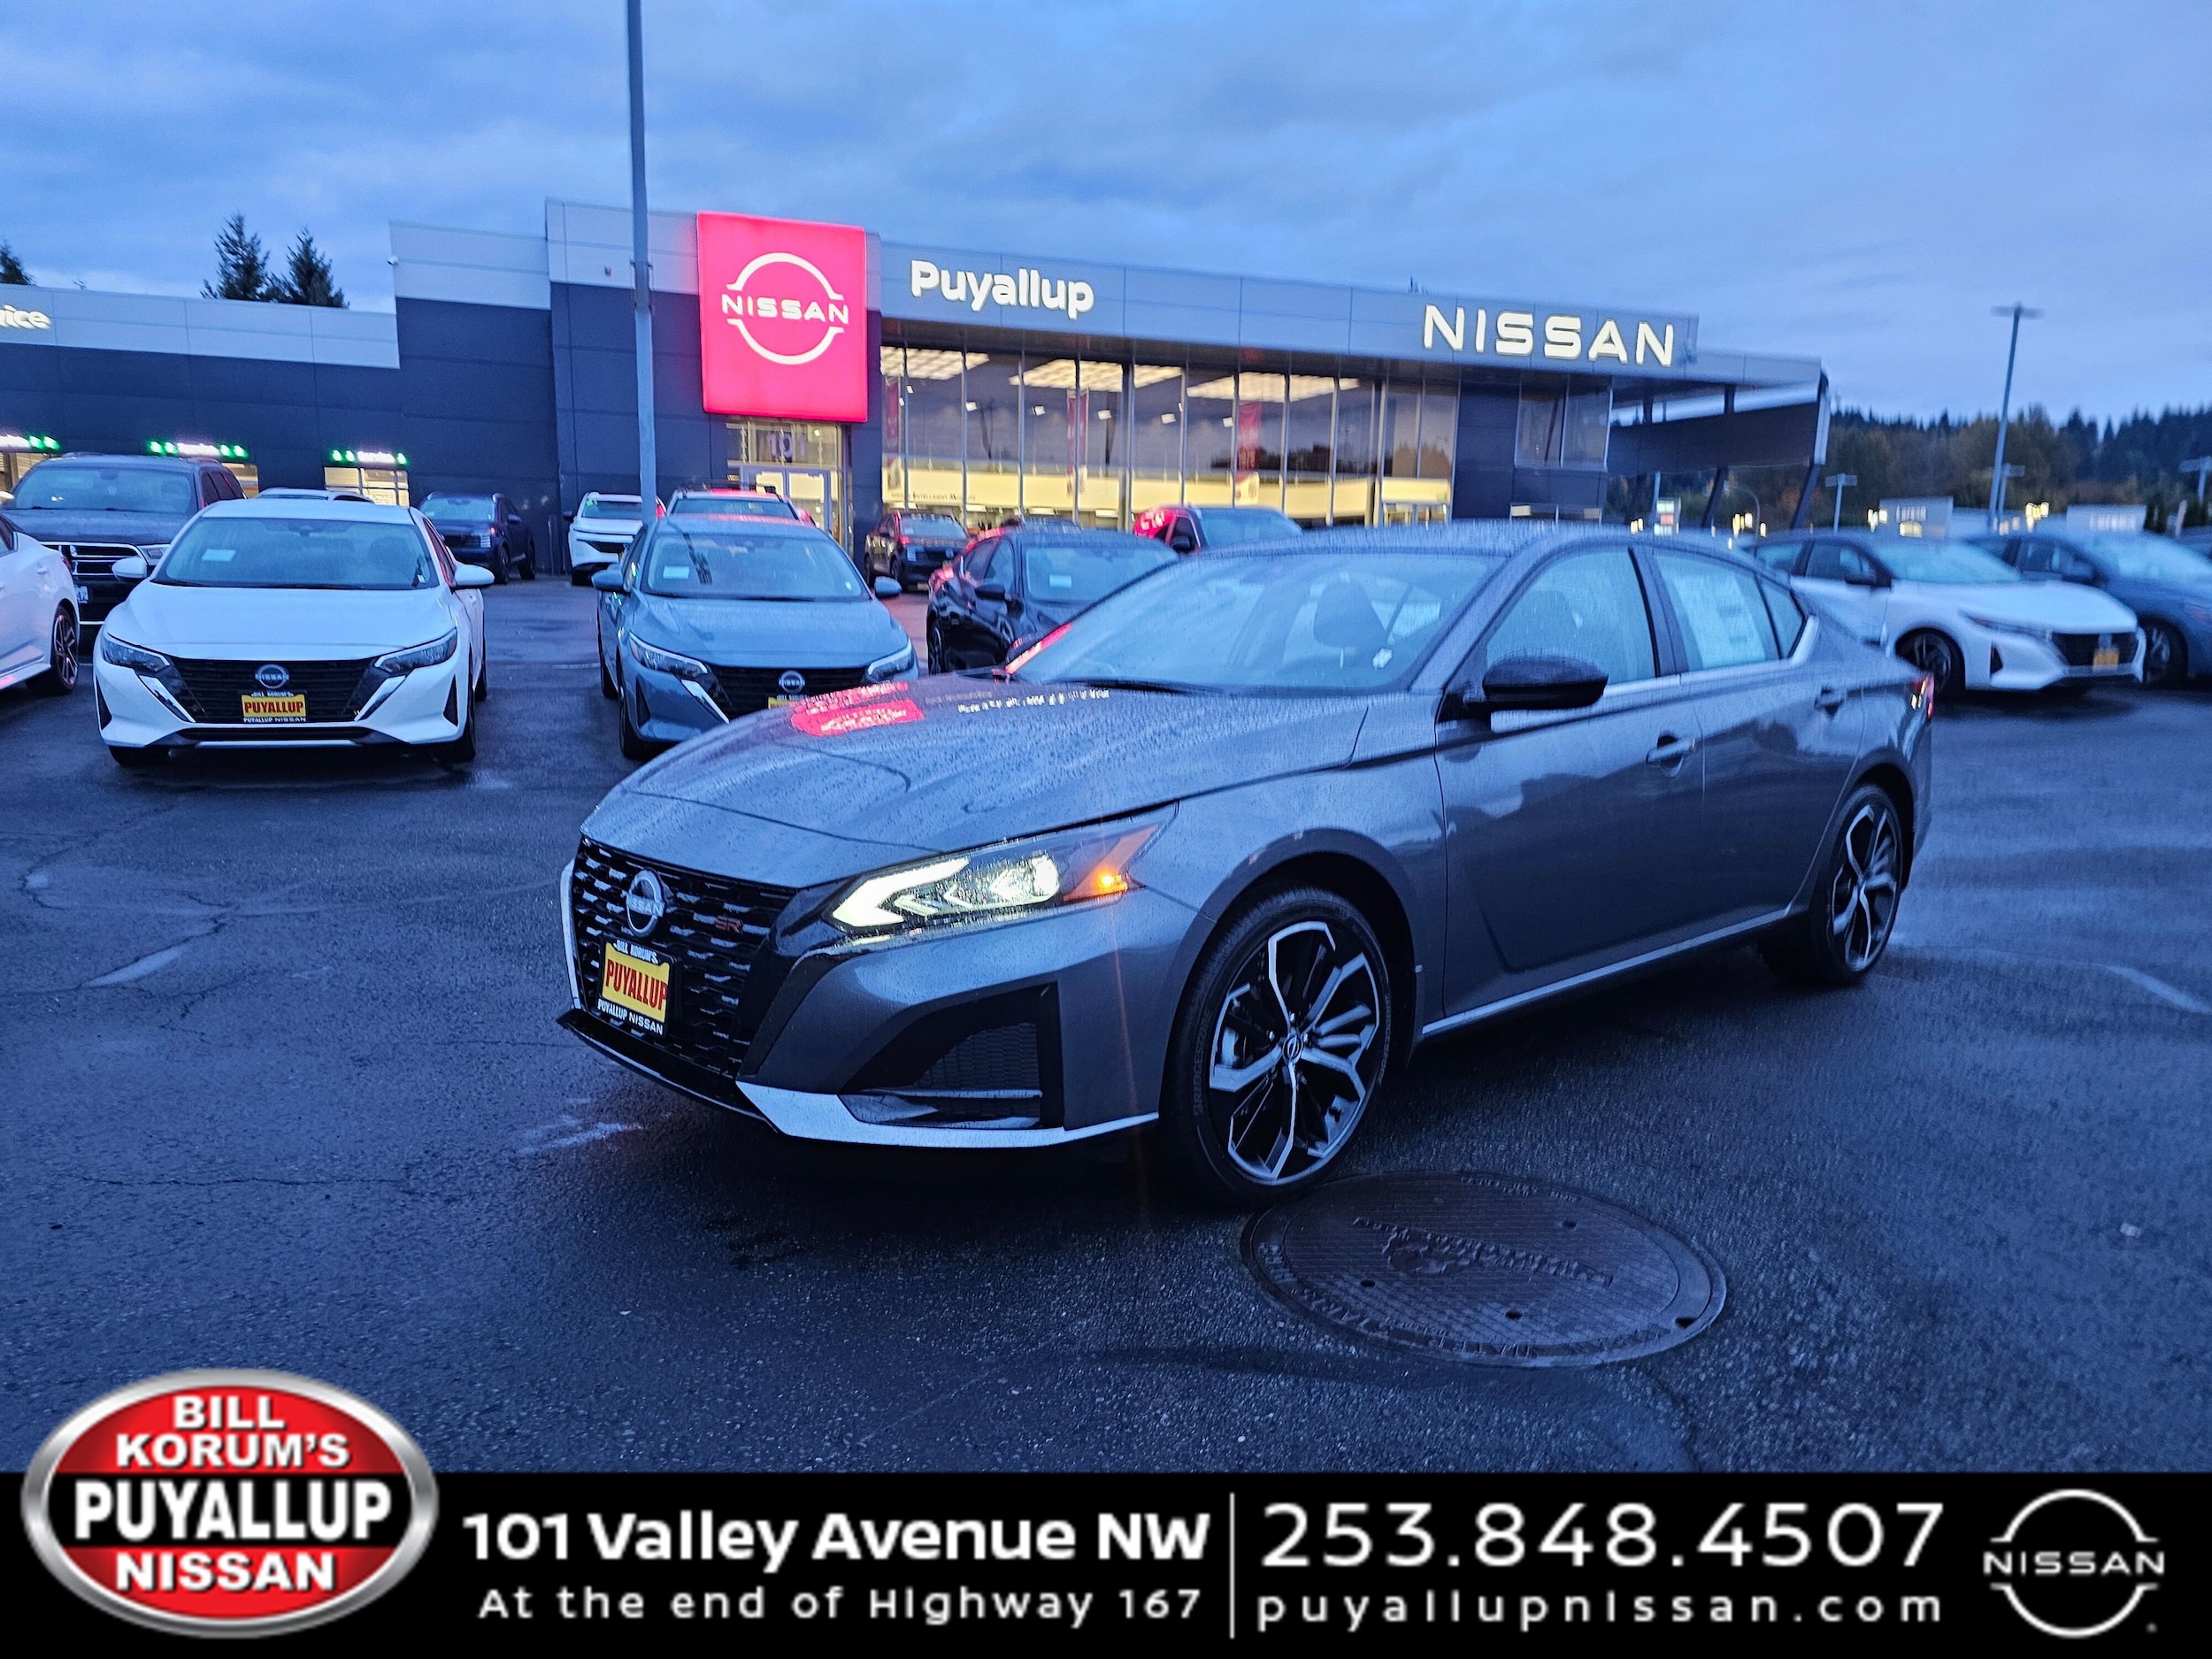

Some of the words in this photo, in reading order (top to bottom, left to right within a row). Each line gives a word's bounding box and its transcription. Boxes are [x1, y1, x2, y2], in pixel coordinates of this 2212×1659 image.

[911, 259, 1094, 320] Puyallup
[721, 294, 849, 325] NISSAN
[1424, 304, 1674, 367] NISSAN
[766, 431, 806, 458] 101
[243, 701, 303, 713] PUYALLUP
[626, 892, 664, 918] ISSAN
[617, 939, 629, 955] BILL
[605, 958, 668, 1011] PUYALLUP
[597, 998, 628, 1020] PUYALLUP
[628, 1012, 663, 1036] NISSAN
